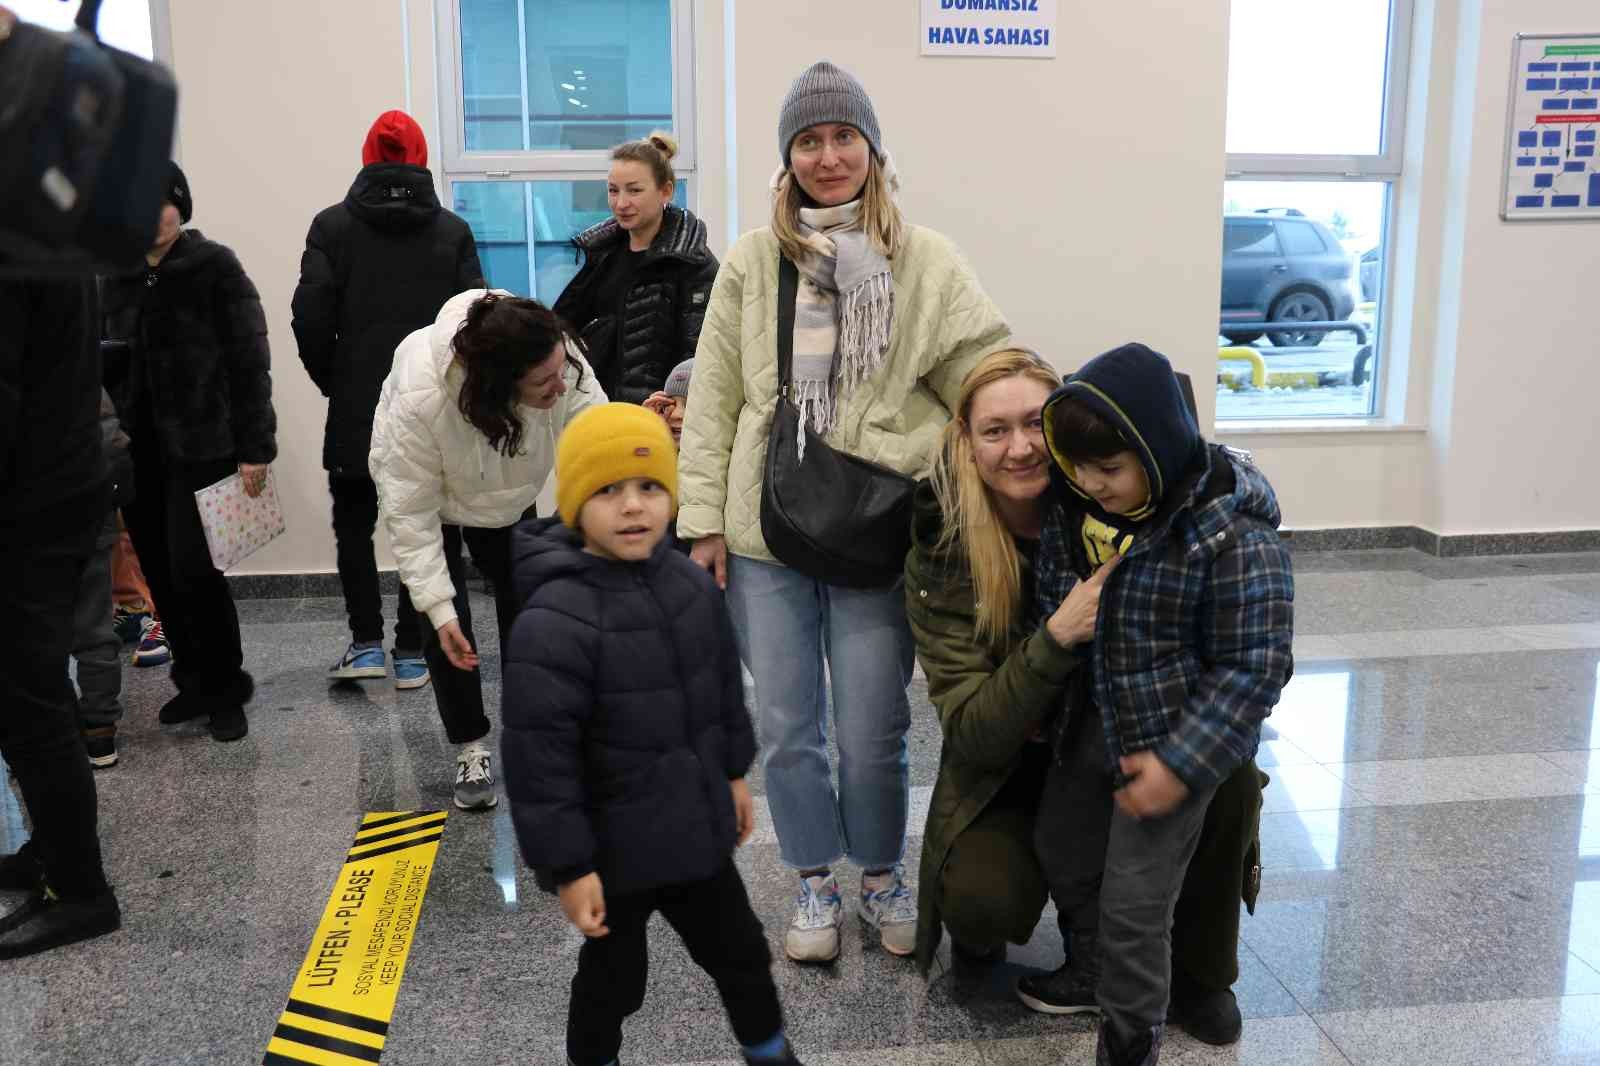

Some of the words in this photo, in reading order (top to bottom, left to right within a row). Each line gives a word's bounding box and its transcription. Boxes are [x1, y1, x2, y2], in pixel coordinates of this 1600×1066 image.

[928, 27, 980, 44] HAVA
[984, 27, 1049, 45] SAHASI
[404, 864, 428, 901] DISTANCE
[306, 930, 352, 988] LÜTFEN
[335, 868, 374, 918] PLEASE
[394, 902, 416, 932] SOCIAL
[387, 932, 407, 959] YOUR
[353, 958, 379, 995] SOSYAL
[379, 960, 399, 985] KEEP
